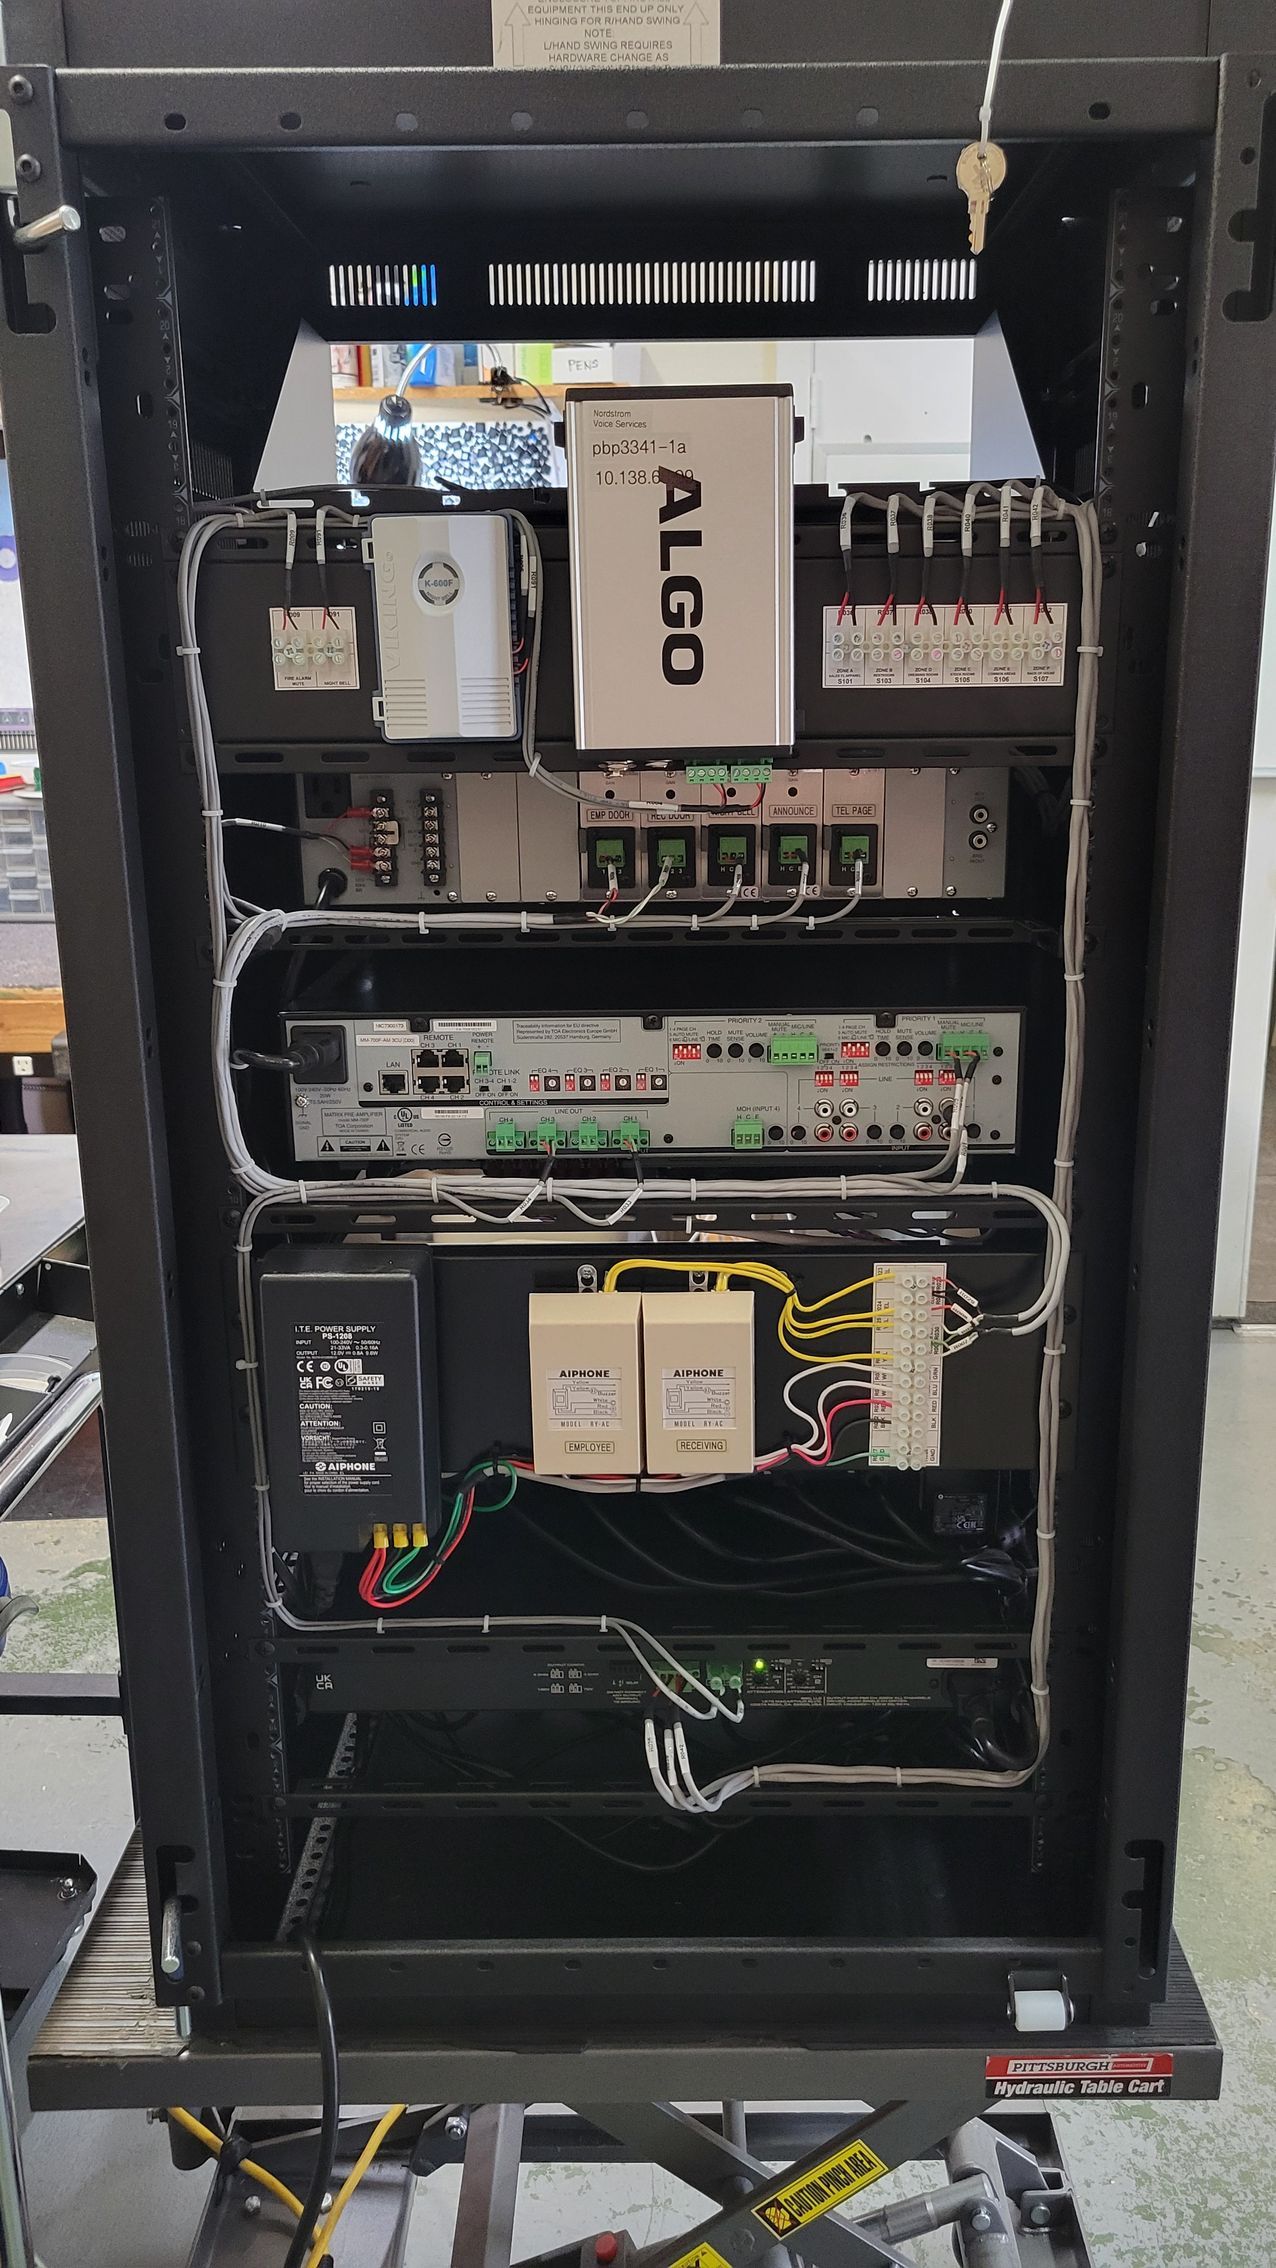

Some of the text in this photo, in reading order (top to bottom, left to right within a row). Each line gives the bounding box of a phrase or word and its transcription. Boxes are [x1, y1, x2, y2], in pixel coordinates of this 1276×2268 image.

[528, 5, 684, 14] EQUIPMENT THIS END UP ONLY
[534, 17, 680, 25] HINGING FOR R/HAND SWING
[584, 28, 614, 38] NOTE:
[543, 41, 673, 50] L/HAND SWING REQUIRES
[549, 53, 669, 62] HARDWARE CHANGE AS
[568, 359, 599, 372] PENS
[593, 409, 632, 418] Nordstrom
[593, 419, 647, 429] Voice Services
[592, 439, 687, 458] pbp3341-1a
[658, 465, 704, 685] ALGO
[424, 579, 453, 587] K-600F
[773, 806, 814, 816] ANNOUNCE
[835, 806, 873, 815] TEL PAGE
[590, 811, 630, 820] EMP DOOR
[345, 1325, 376, 1333] SUPPLY
[296, 1360, 314, 1373] CE
[559, 1369, 610, 1378] AIPHONE
[673, 1369, 724, 1377] AIPHONE
[569, 1443, 611, 1452] EMPLOYEE
[680, 1441, 723, 1450] RECEIVING
[328, 1462, 376, 1471] AIPHONE
[316, 1682, 333, 1690] CA
[1012, 2061, 1110, 2072] PITTSBURGH
[994, 2078, 1165, 2098] Hydraulic Table Cart
[783, 2150, 878, 2217] CAUTION PINCH AREA
